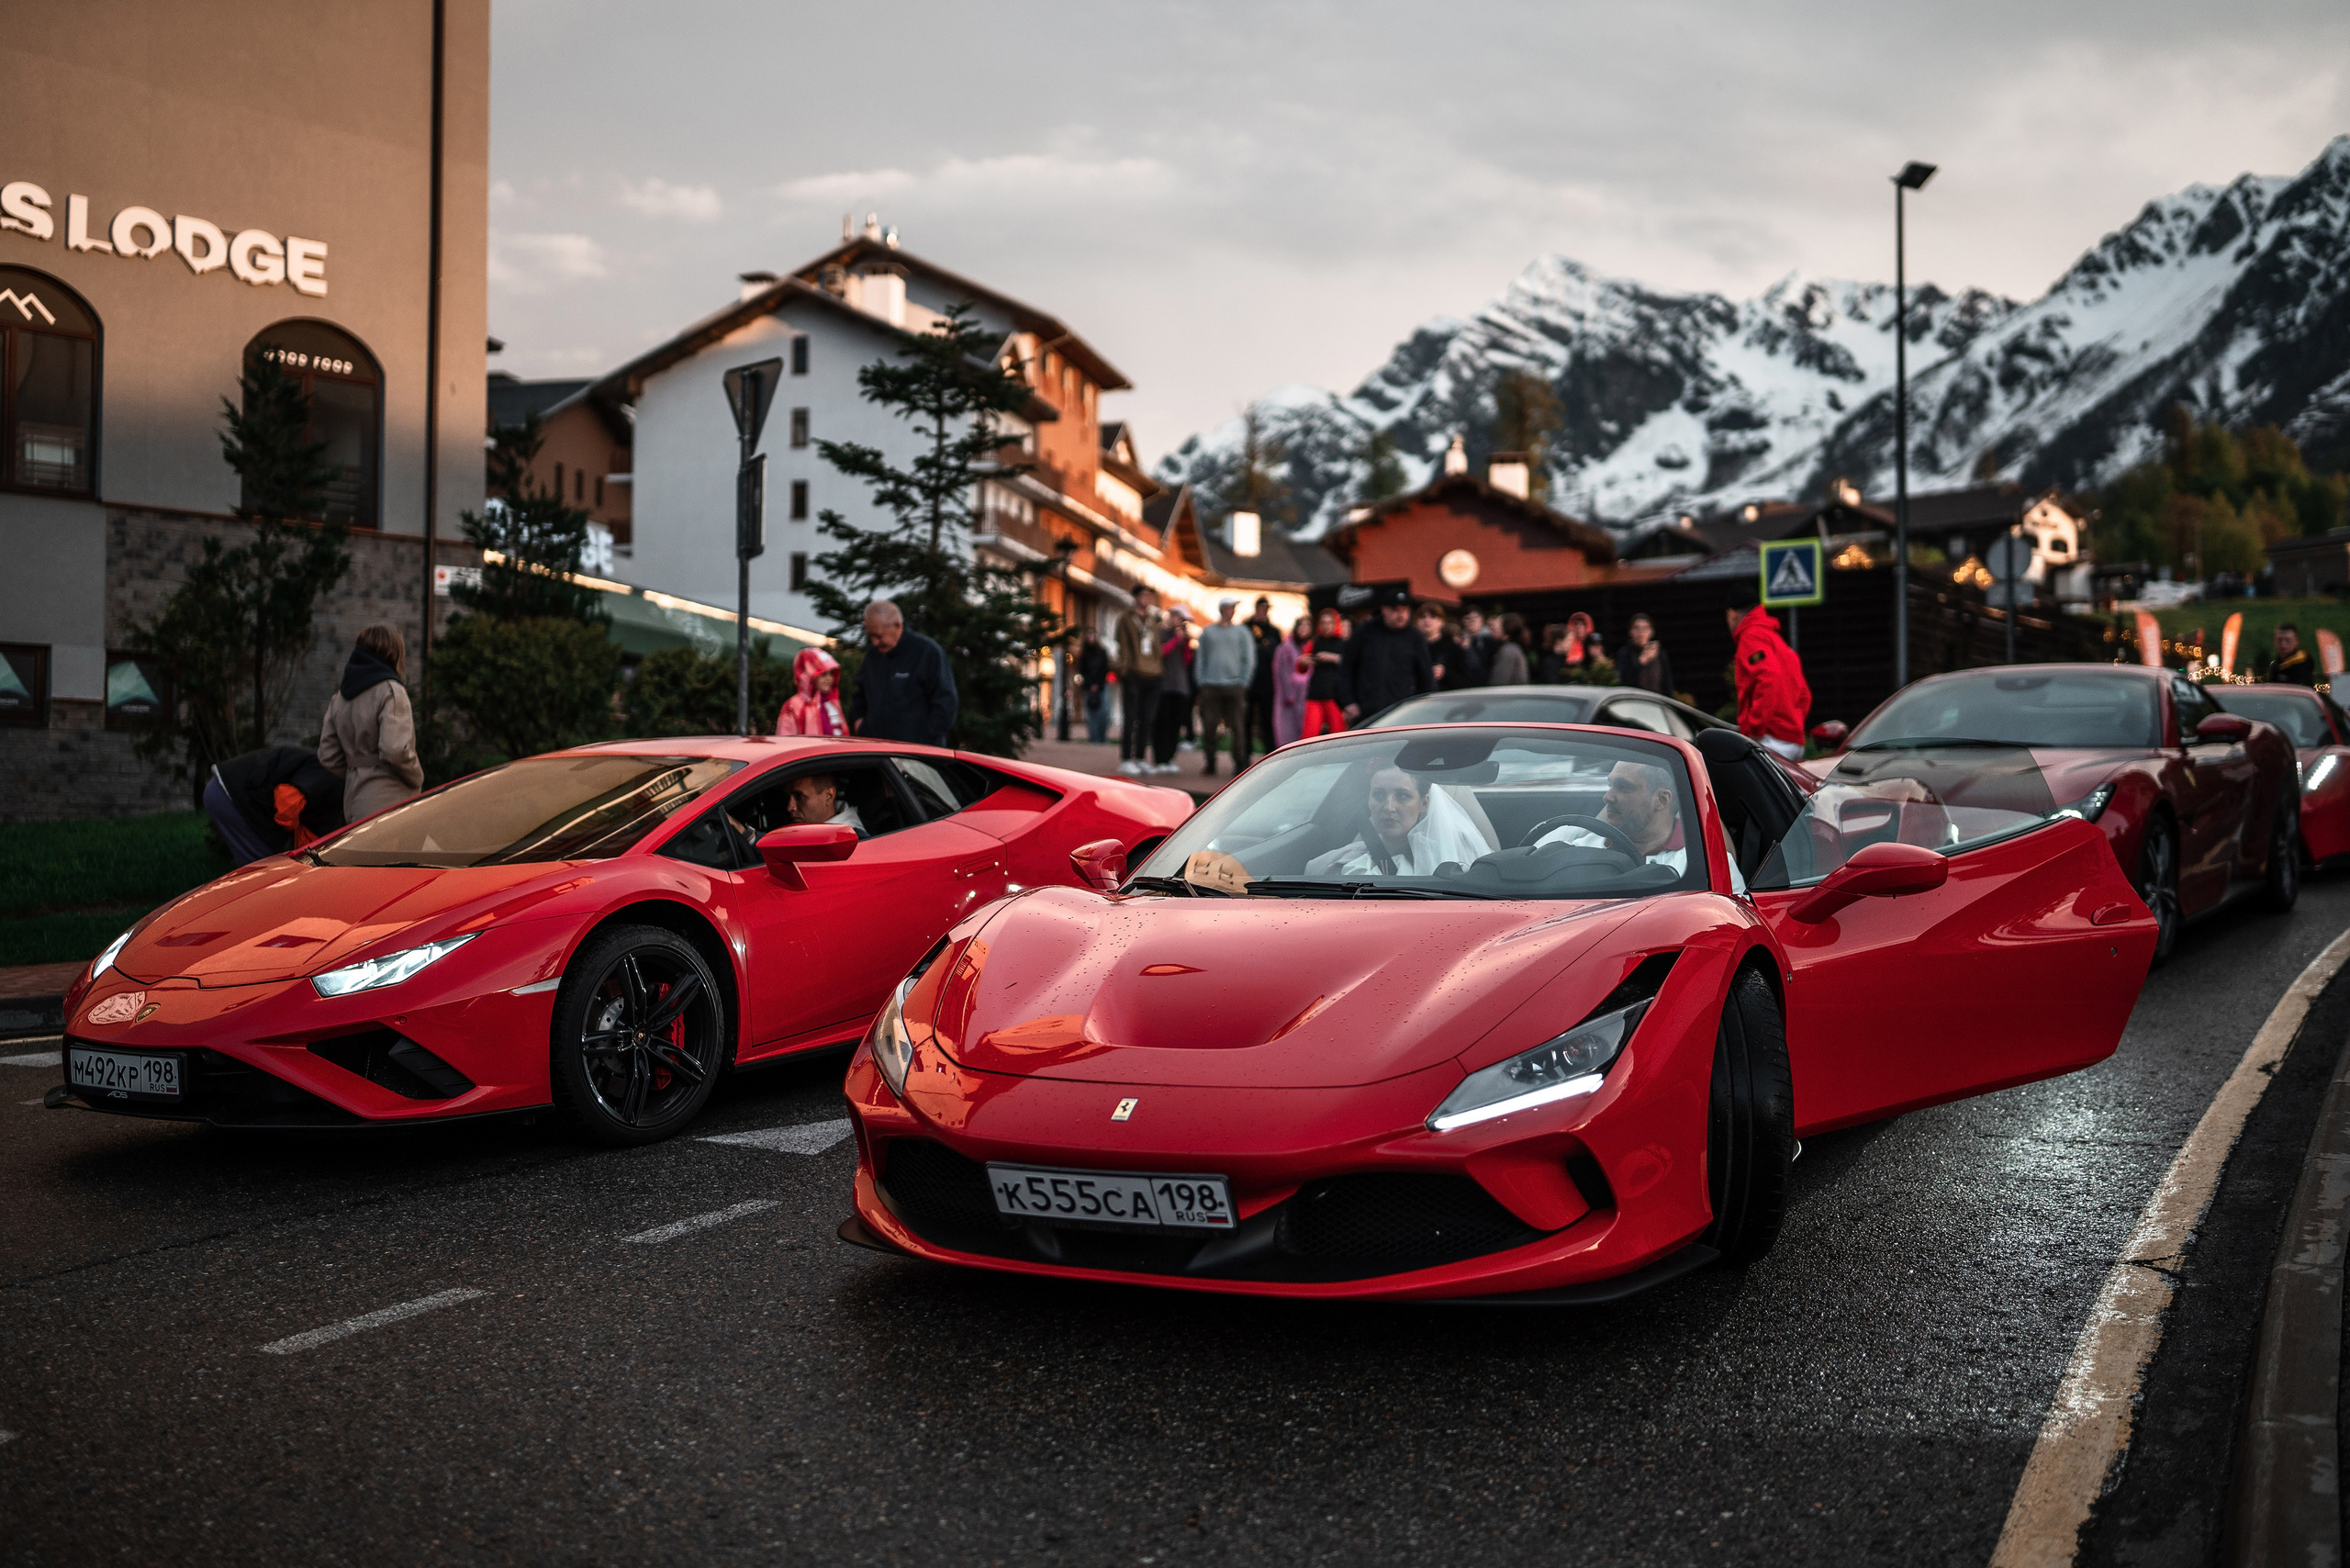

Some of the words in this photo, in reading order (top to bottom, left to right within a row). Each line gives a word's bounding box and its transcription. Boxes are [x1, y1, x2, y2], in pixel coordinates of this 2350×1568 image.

[66, 193, 328, 298] LODGE
[313, 355, 353, 375] FOOD
[143, 1059, 174, 1084] 198
[150, 1083, 165, 1092] RUS
[1158, 1182, 1218, 1212] 198
[1176, 1210, 1206, 1223] RUS
